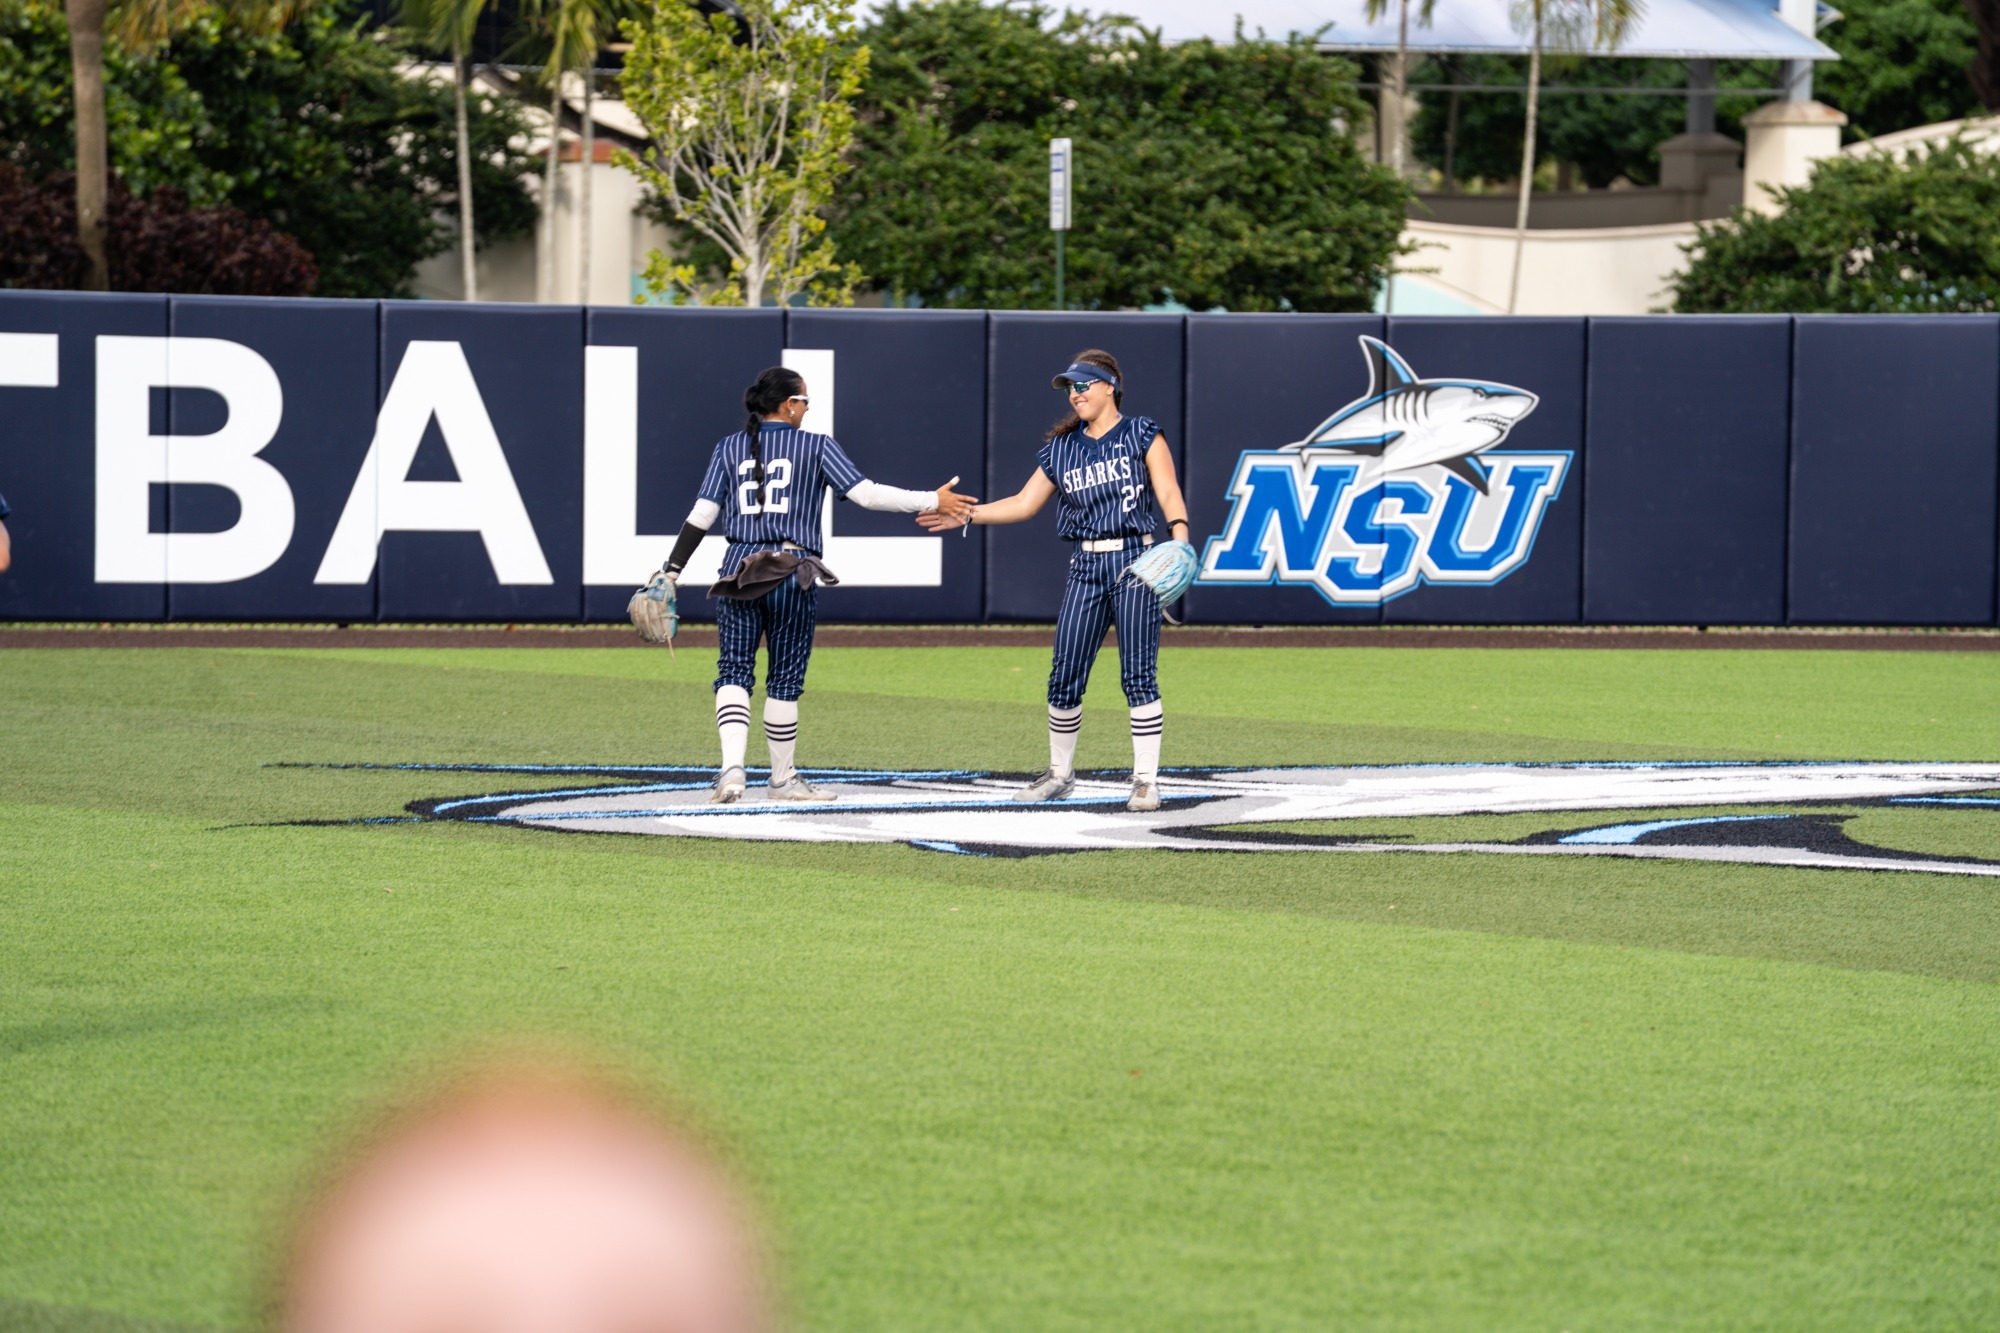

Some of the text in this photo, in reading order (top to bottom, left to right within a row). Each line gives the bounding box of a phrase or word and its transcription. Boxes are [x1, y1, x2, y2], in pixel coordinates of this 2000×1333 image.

[0, 332, 943, 587] BALL
[738, 458, 792, 515] 22
[1063, 456, 1132, 494] SHARKS
[1197, 451, 1573, 606] NSU
